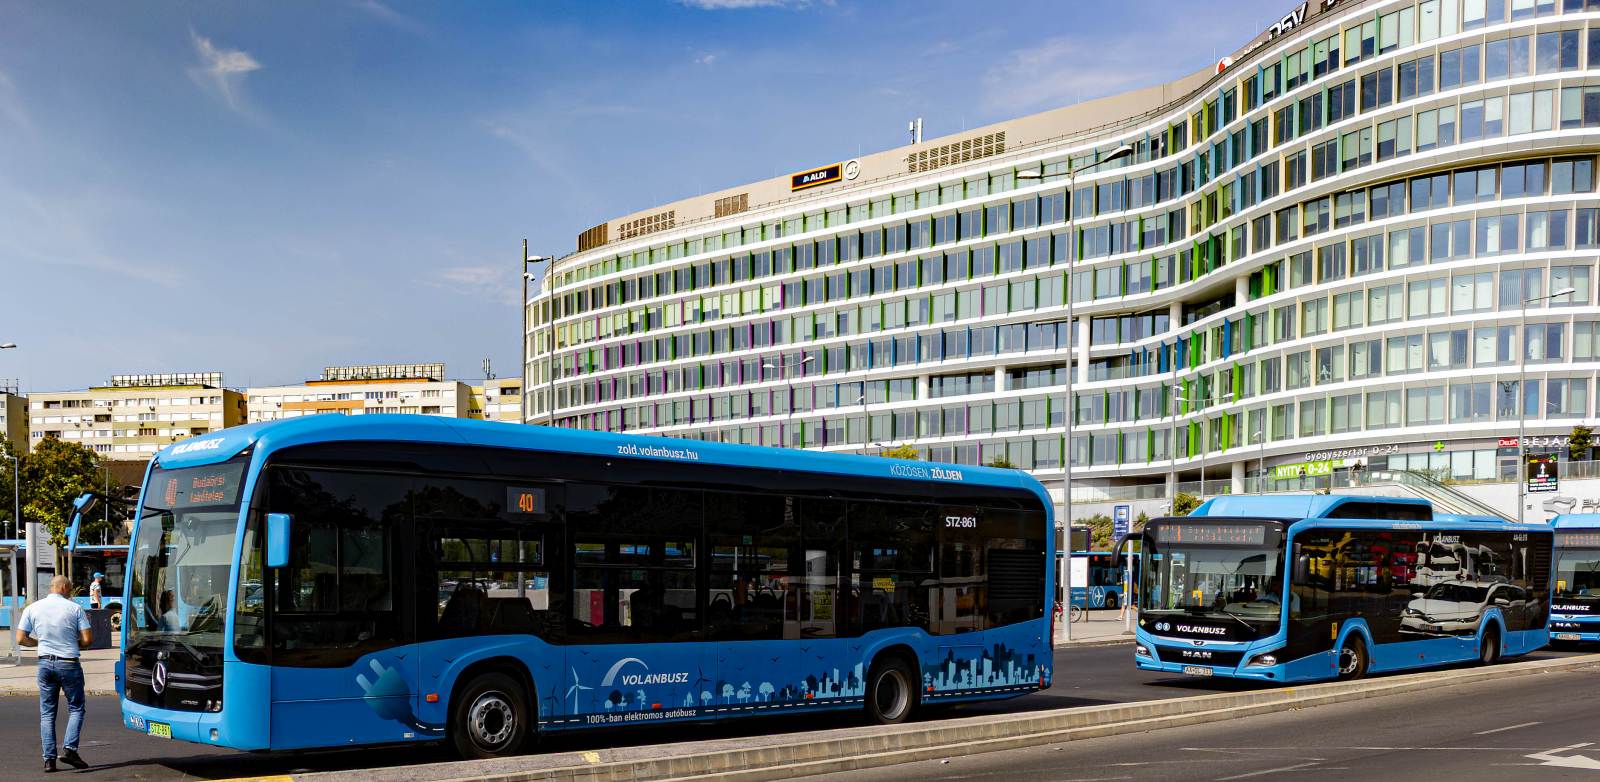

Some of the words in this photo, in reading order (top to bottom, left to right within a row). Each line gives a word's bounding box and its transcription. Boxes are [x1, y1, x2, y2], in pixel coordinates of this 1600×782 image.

[810, 171, 827, 181] ALDI
[617, 443, 699, 460] zold.volanbusz.hu
[1372, 444, 1399, 454] 0-24
[930, 467, 963, 480] ZÖLDEN
[1278, 464, 1306, 477] NYITV
[1308, 462, 1329, 474] 0-24
[519, 493, 534, 512] 40
[945, 516, 976, 528] STZ-861
[1182, 650, 1212, 659] MAN
[586, 714, 622, 724] 100%-ban
[624, 711, 664, 721] elektromos
[665, 708, 697, 718] autóbusz
